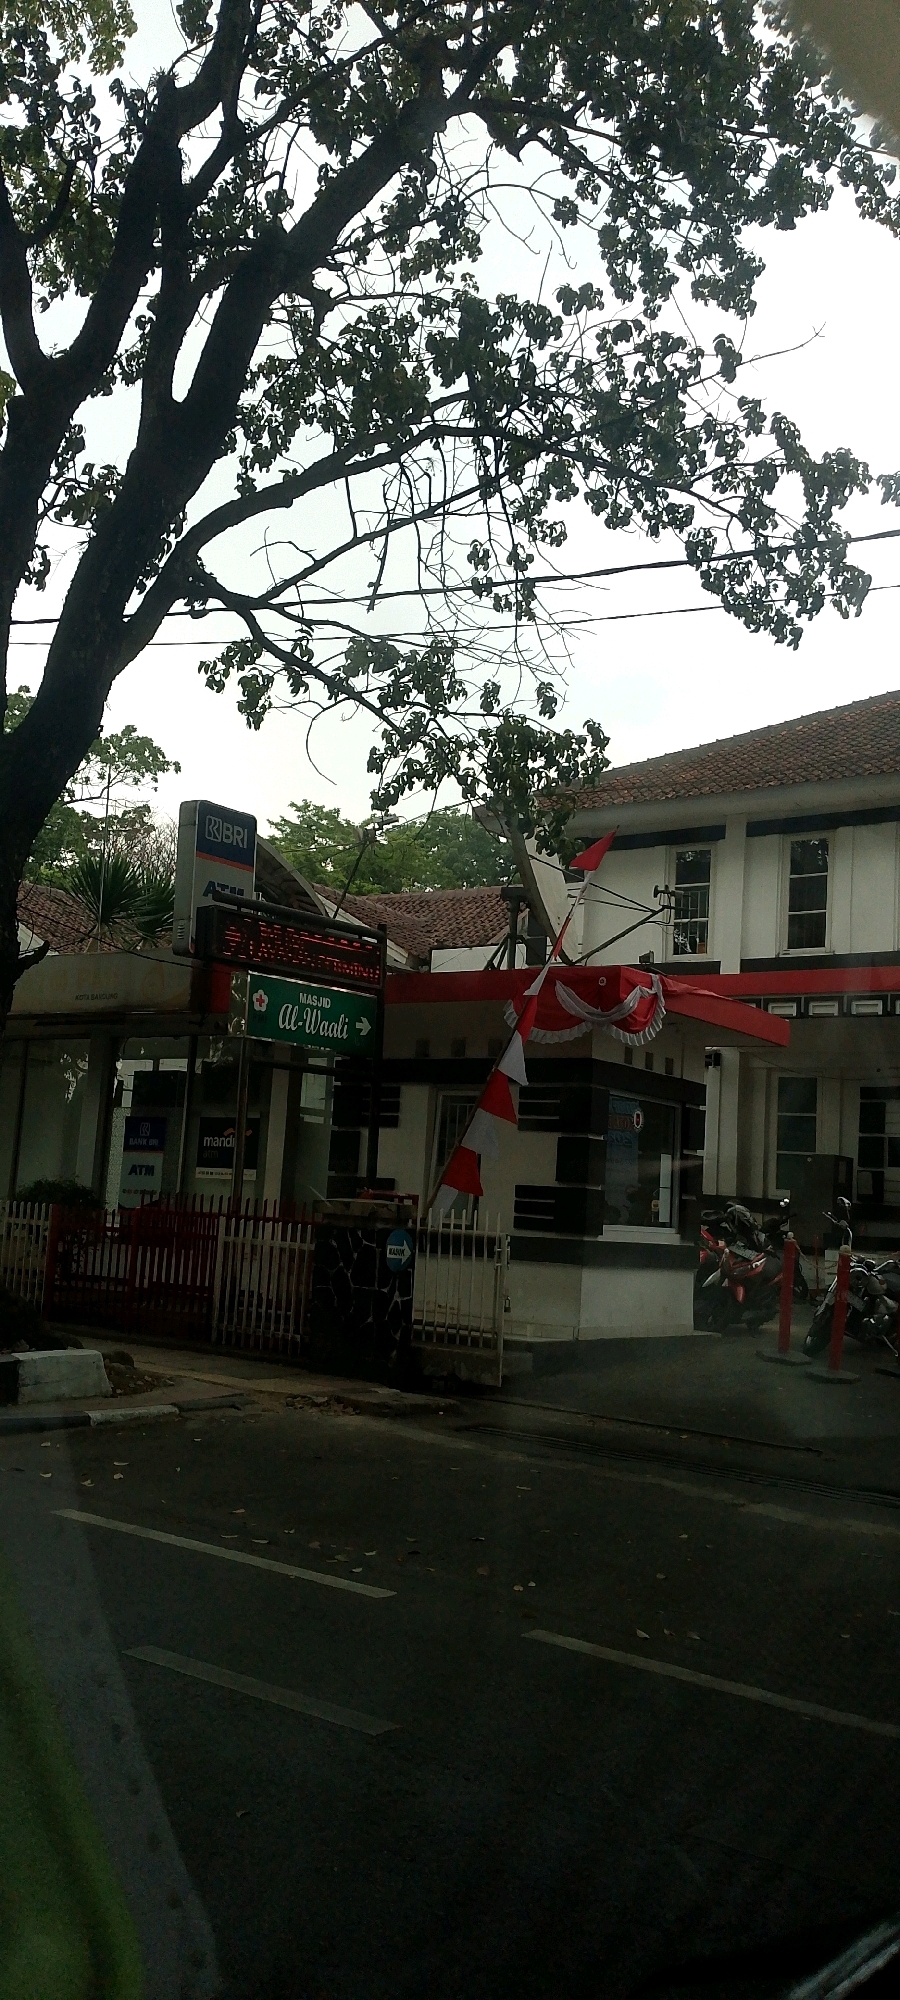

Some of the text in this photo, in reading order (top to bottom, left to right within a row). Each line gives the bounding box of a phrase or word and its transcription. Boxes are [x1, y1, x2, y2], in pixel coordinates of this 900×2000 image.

[222, 822, 248, 849] BRI
[202, 880, 245, 897] ATM
[299, 992, 332, 1009] MASJID
[278, 1003, 350, 1040] Al-Waali
[129, 1138, 160, 1146] BANK BRI
[203, 1136, 235, 1148] mandi
[203, 1150, 219, 1159] atm
[128, 1164, 155, 1177] ATM
